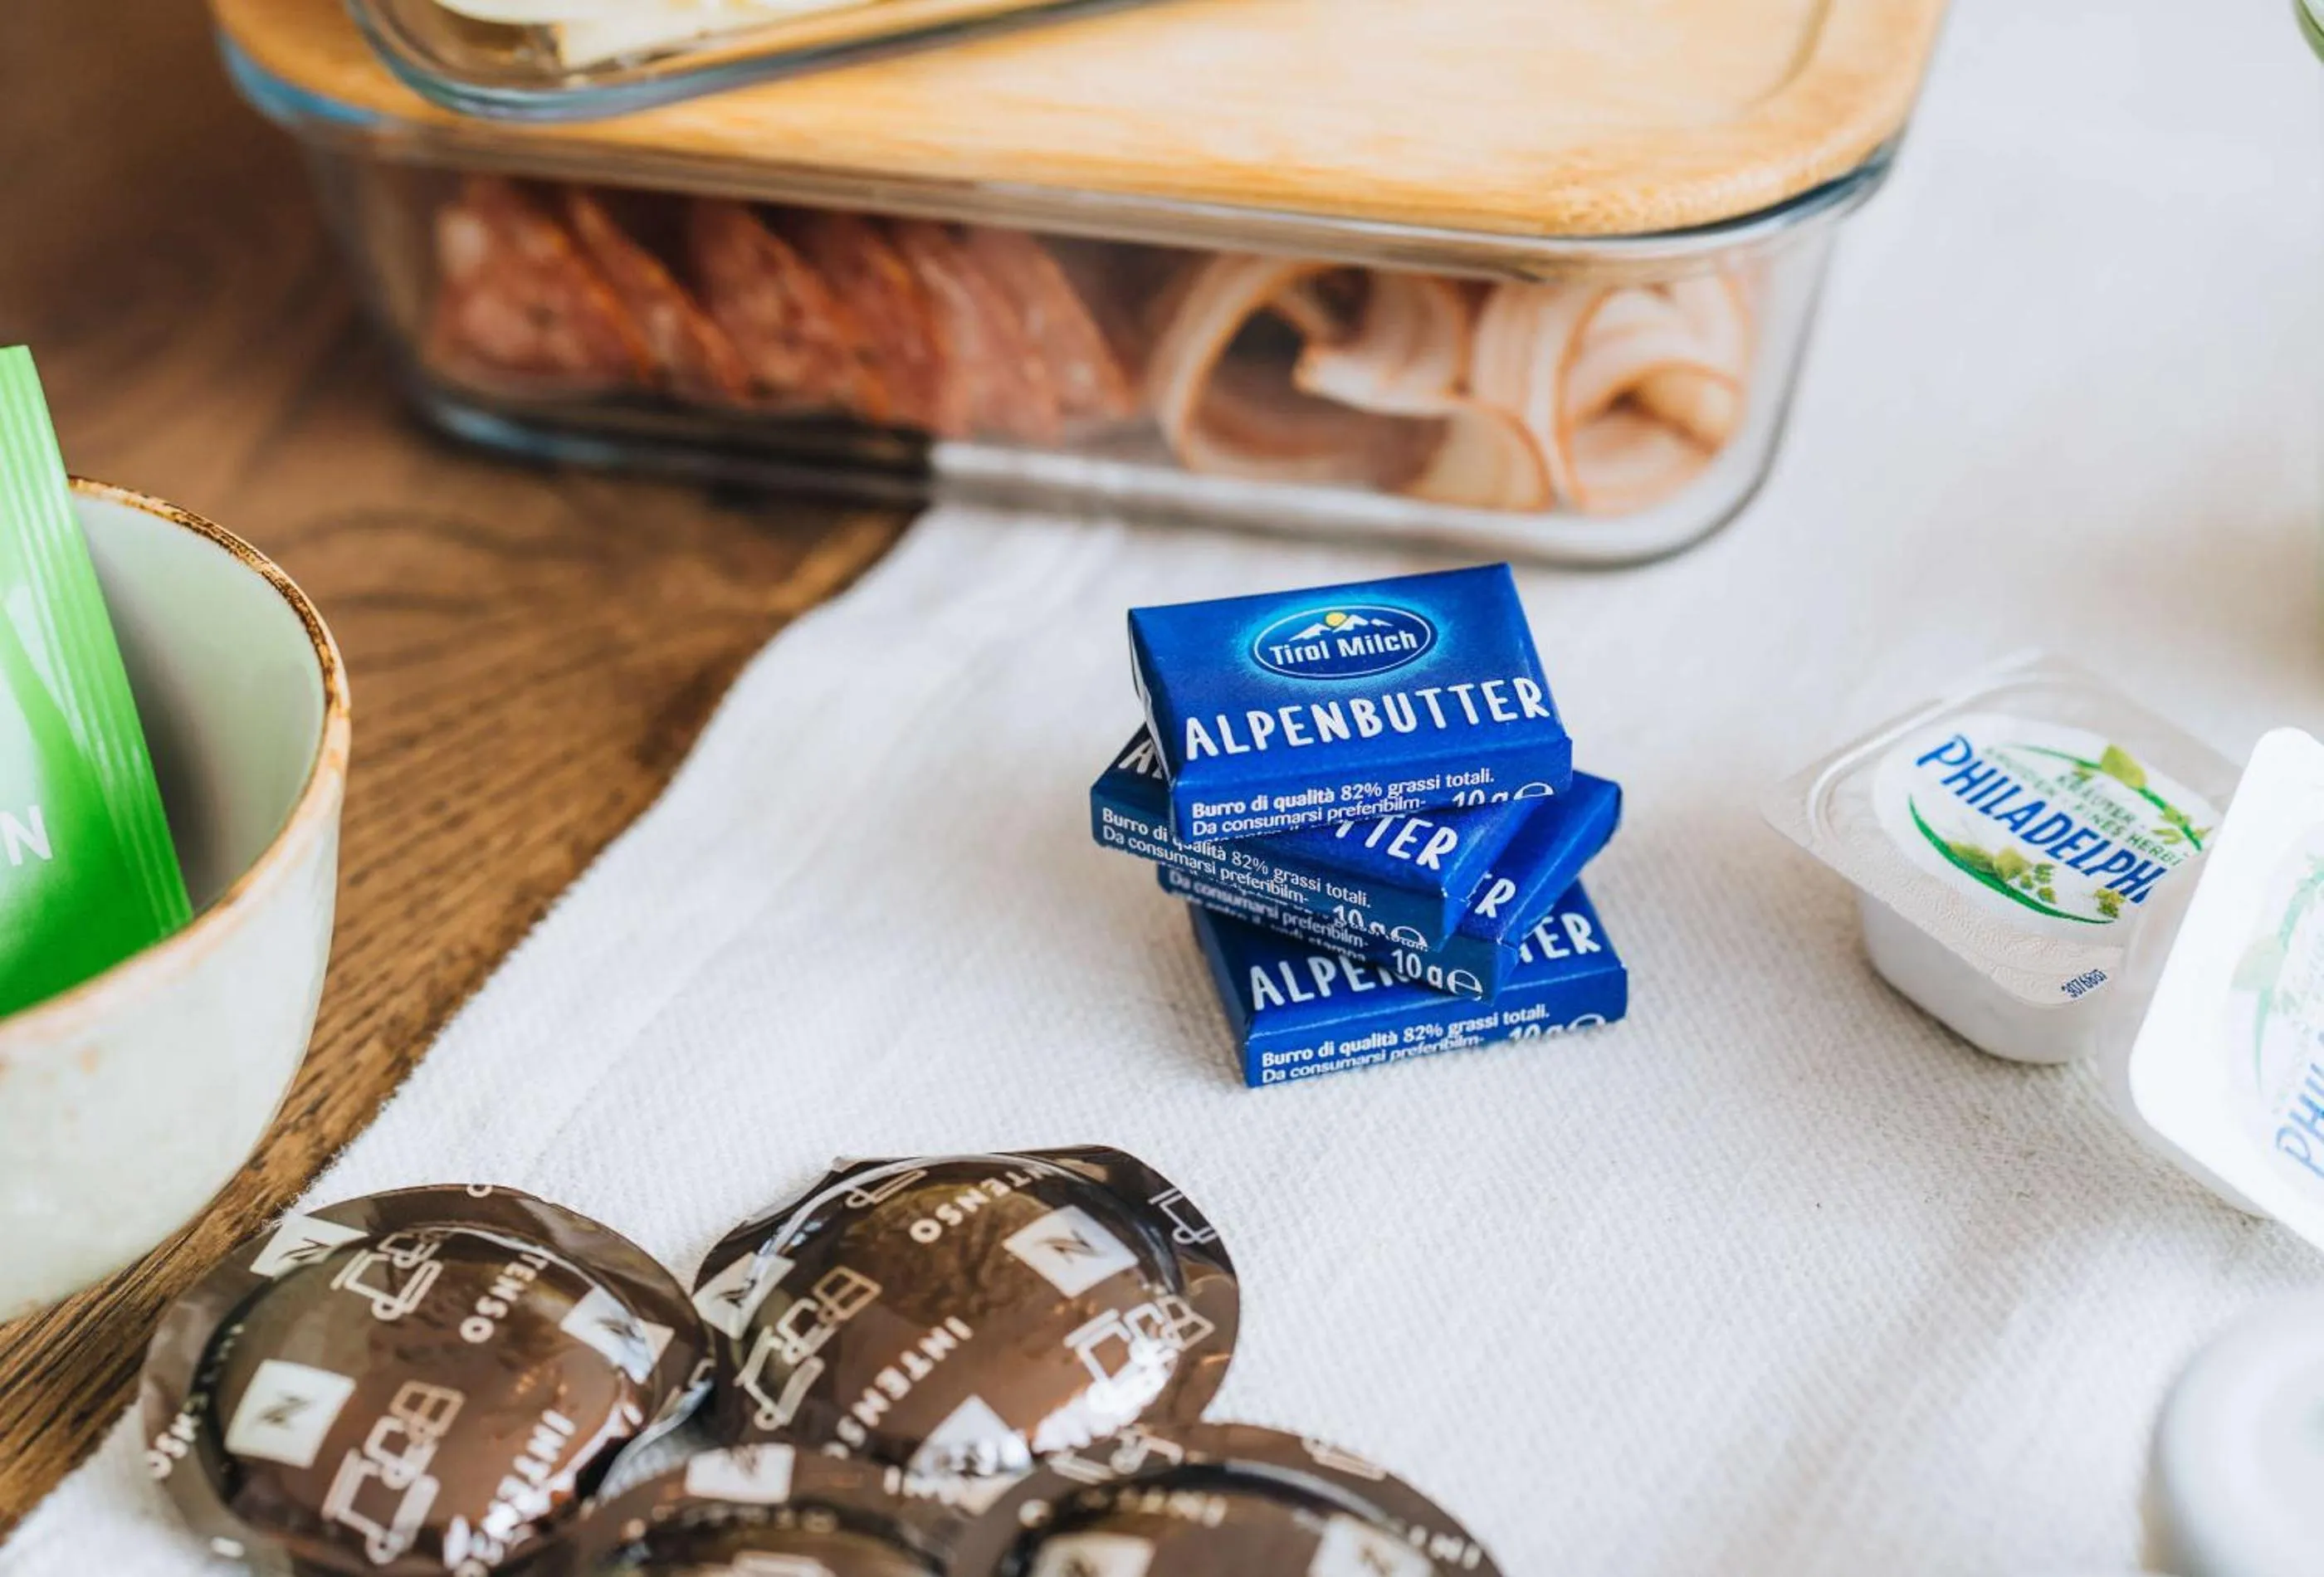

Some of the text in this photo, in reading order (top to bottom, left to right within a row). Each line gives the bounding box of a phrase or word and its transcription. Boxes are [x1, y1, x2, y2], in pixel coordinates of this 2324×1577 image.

[1270, 629, 1418, 666] Tirol Milch
[1186, 676, 1550, 761] ALPENBUTTER
[1192, 767, 1495, 819] Burro di qualità 82% grassi totali.
[1193, 820, 1217, 837] Da
[1222, 808, 1322, 832] consumarsi
[1102, 807, 1149, 836] Burro
[1153, 825, 1168, 842] di
[1232, 851, 1269, 876] 82%
[1273, 868, 1321, 893] grassi
[1326, 881, 1371, 908] totali.
[1103, 825, 1125, 845] Da
[1129, 836, 1216, 875] consumarsi
[1169, 872, 1191, 890] Da
[1391, 950, 1423, 979] 10
[1262, 1003, 1550, 1068] Burro di qualità 82% grassi totali.
[1262, 1068, 1286, 1084] Da
[1290, 1050, 1387, 1078] consumarsi
